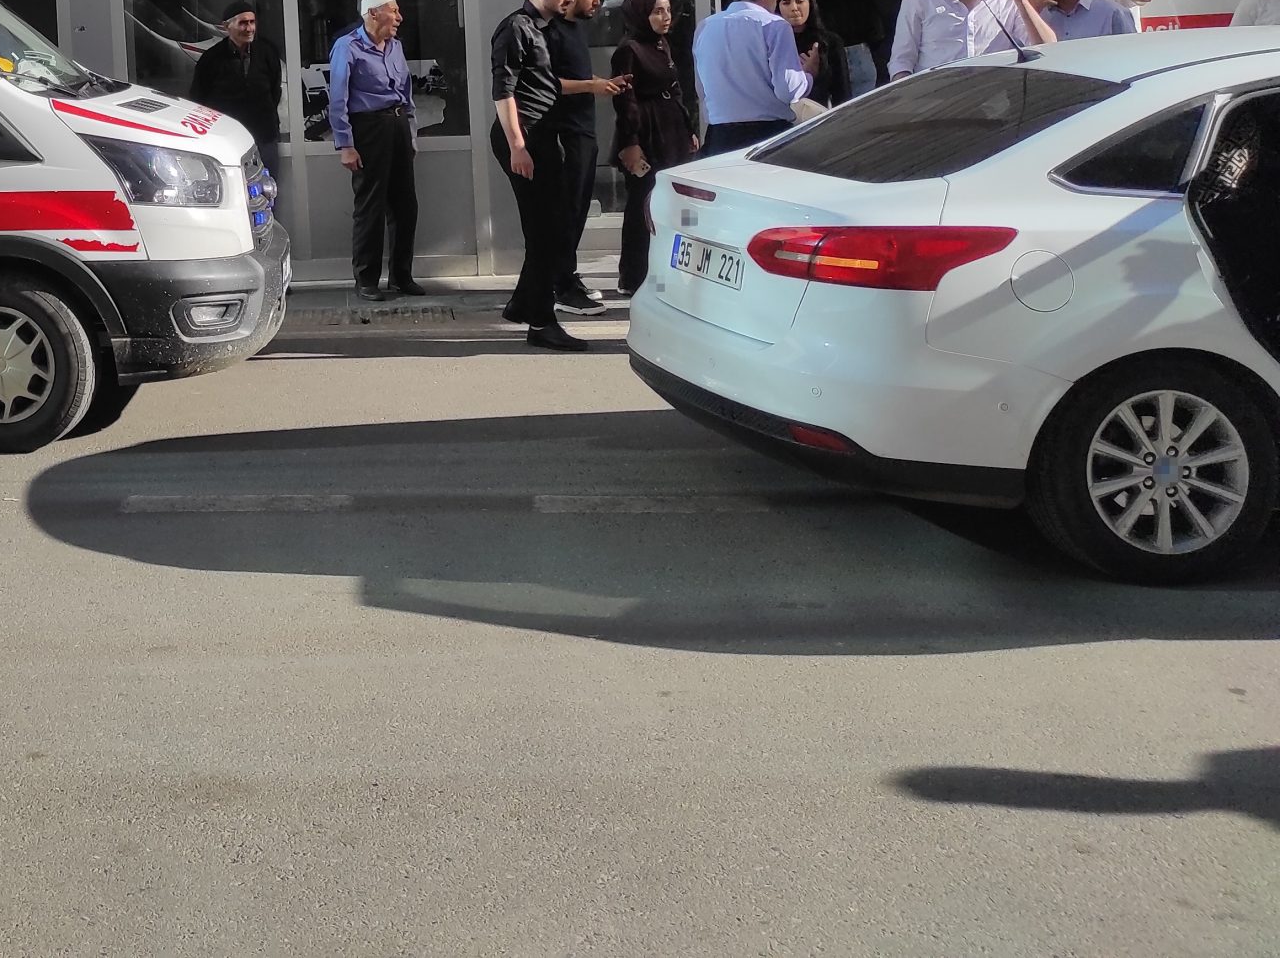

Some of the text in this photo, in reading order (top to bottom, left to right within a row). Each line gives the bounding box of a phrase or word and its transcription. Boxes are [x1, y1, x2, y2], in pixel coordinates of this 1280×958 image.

[678, 241, 740, 284] 35 JM 221
